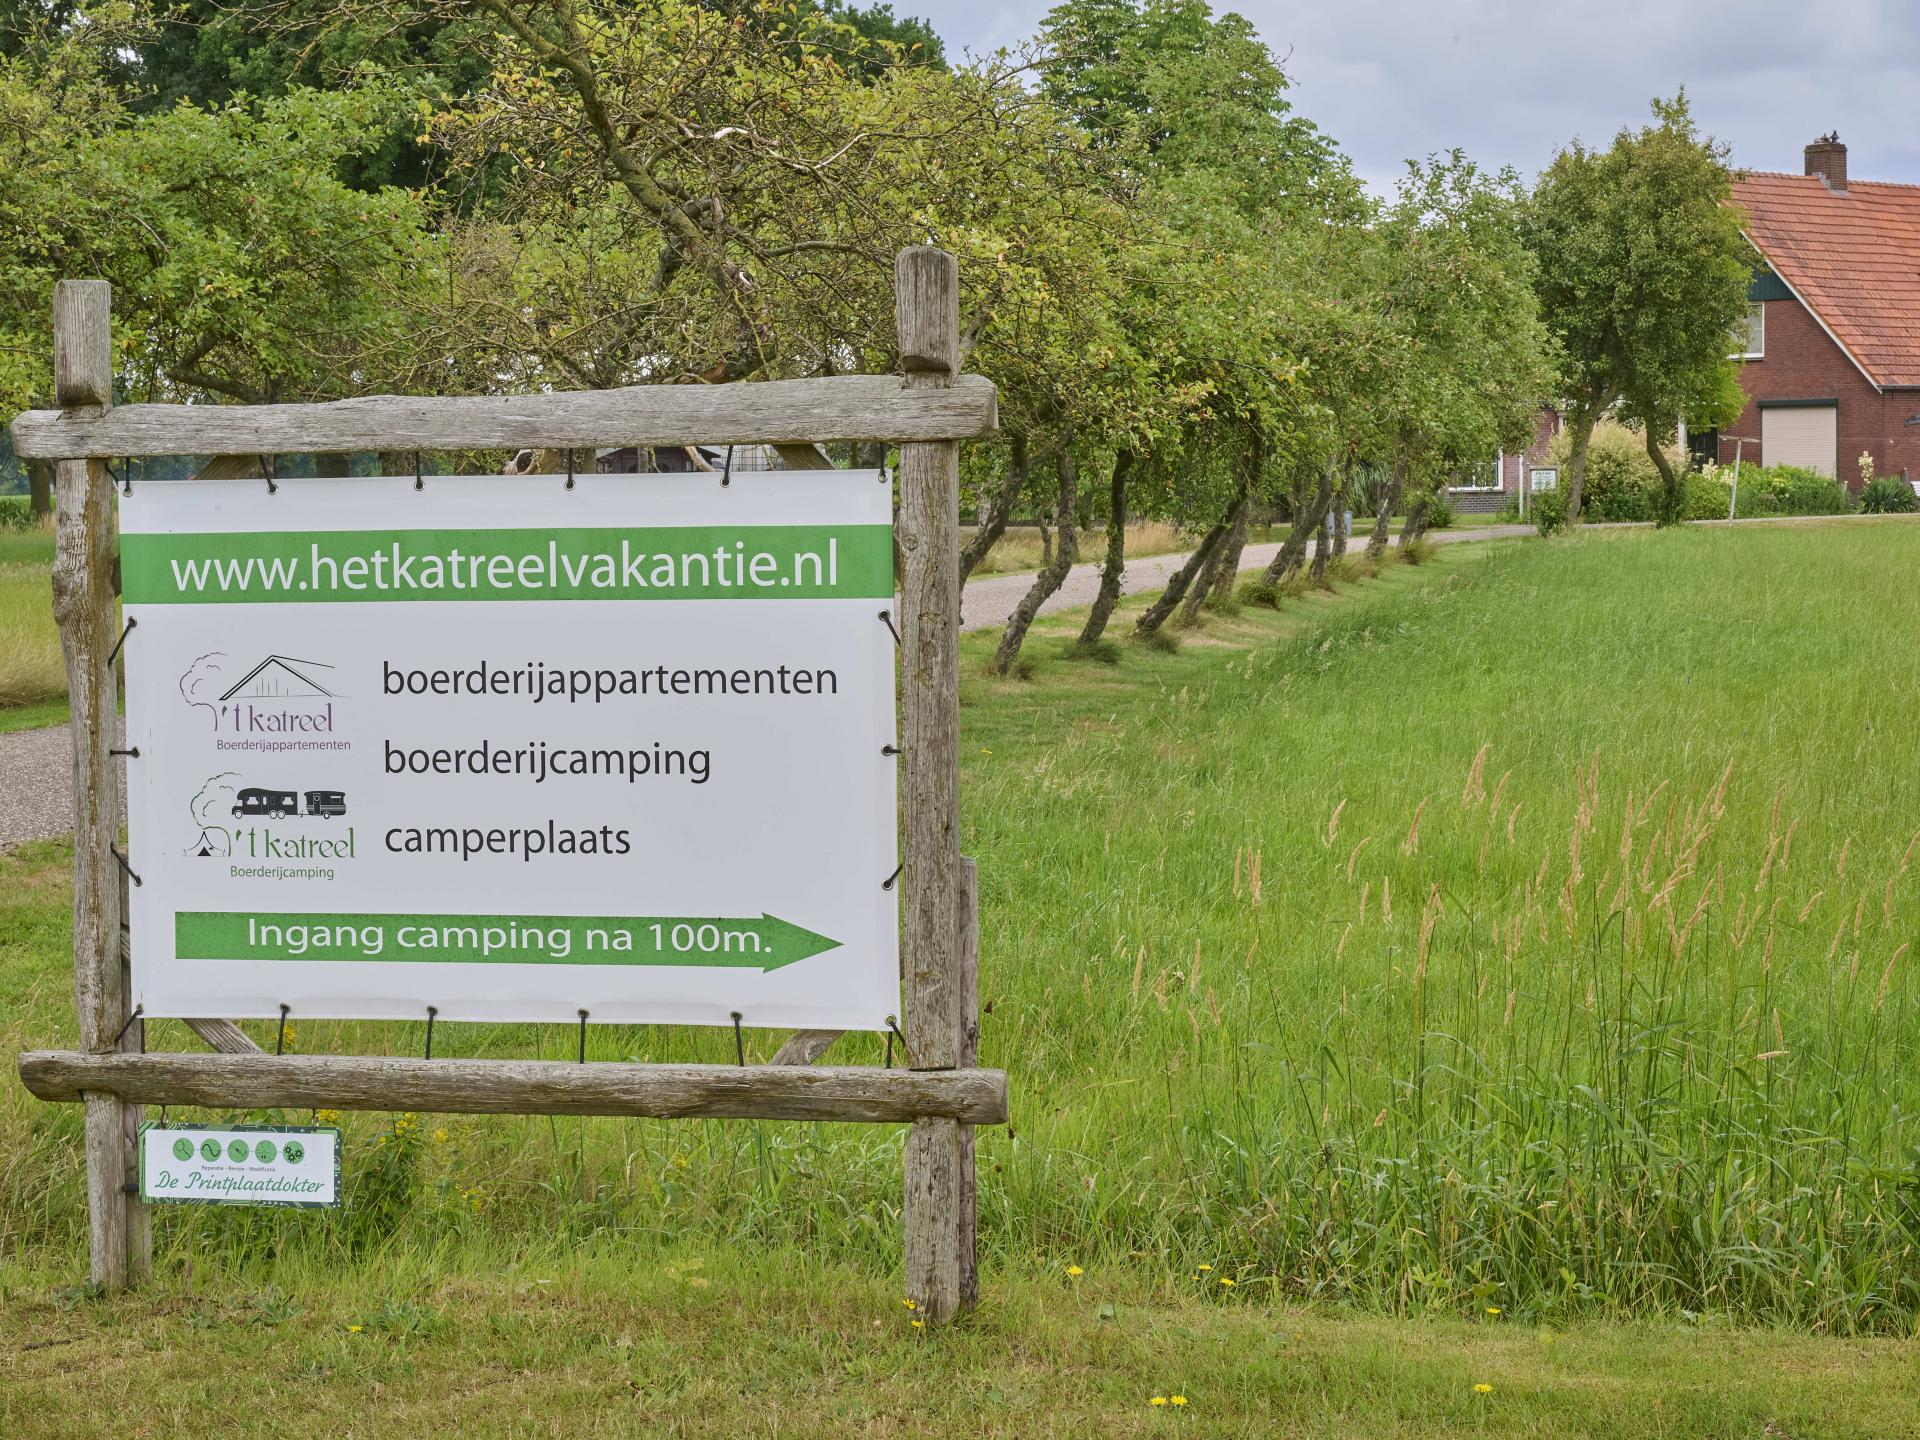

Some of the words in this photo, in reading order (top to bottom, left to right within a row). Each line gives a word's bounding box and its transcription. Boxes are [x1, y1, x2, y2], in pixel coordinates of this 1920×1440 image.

[170, 538, 839, 593] www.hetkatreelvakantie.nl
[383, 660, 838, 704] boerderijappartementen
[248, 702, 333, 732] katreel
[217, 739, 351, 753] Boerderijappartementen
[384, 740, 711, 784] boerderijcamping
[263, 826, 356, 858] katreel
[385, 820, 631, 862] camperplaats
[230, 865, 335, 881] Boerderijcamping
[248, 917, 383, 957] Ingang
[396, 920, 571, 959] camping
[586, 928, 634, 952] na
[651, 921, 774, 954] 100m.
[154, 1170, 179, 1189] De
[184, 1171, 325, 1196] Printplaatdokter
